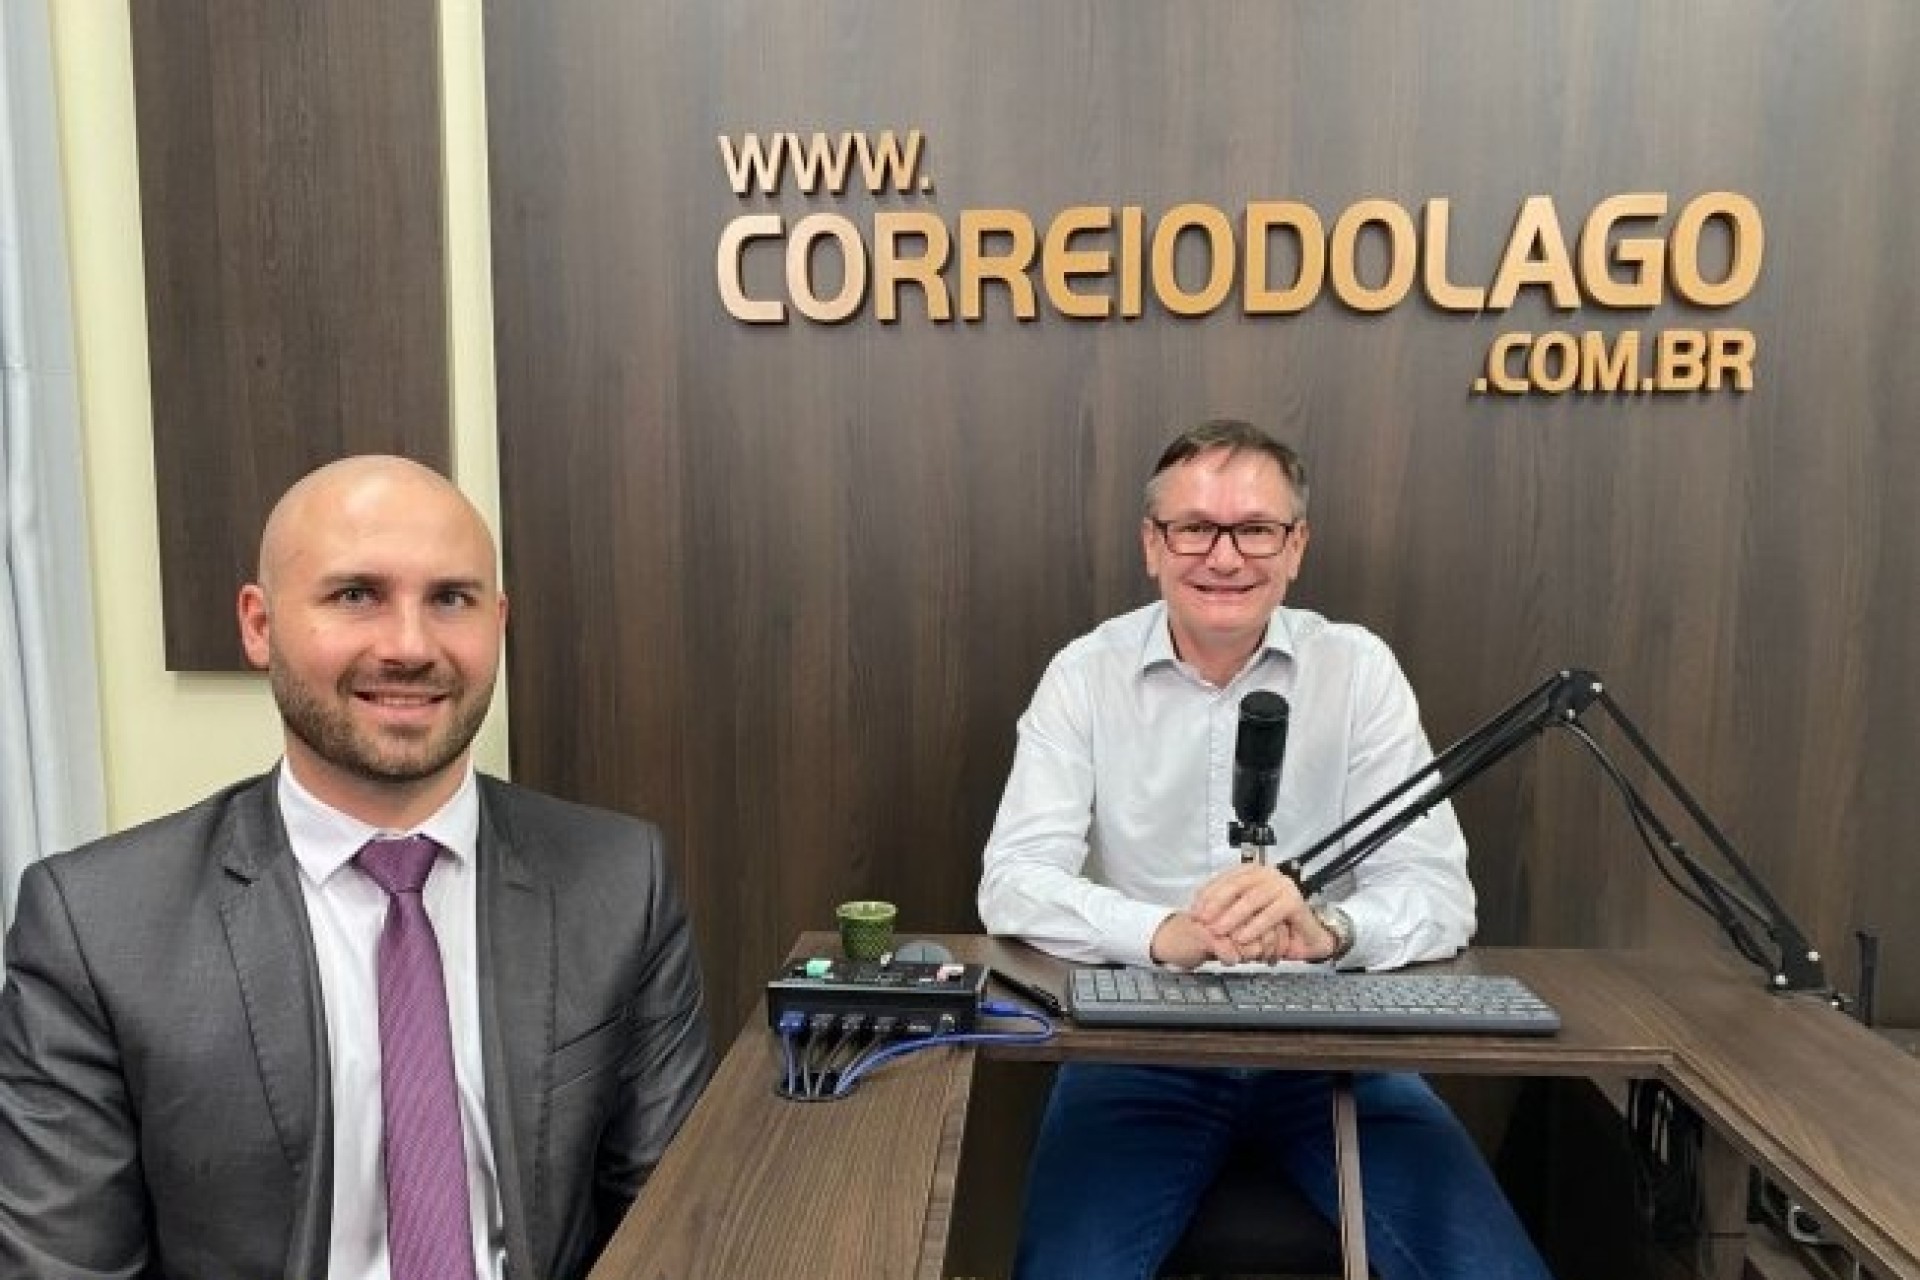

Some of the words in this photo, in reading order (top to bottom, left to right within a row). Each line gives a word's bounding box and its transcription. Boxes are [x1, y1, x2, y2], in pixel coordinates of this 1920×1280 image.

[718, 130, 932, 194] WWW.
[716, 191, 1765, 323] CORREIODOLAGO
[1473, 328, 1757, 393] .COM.BR
